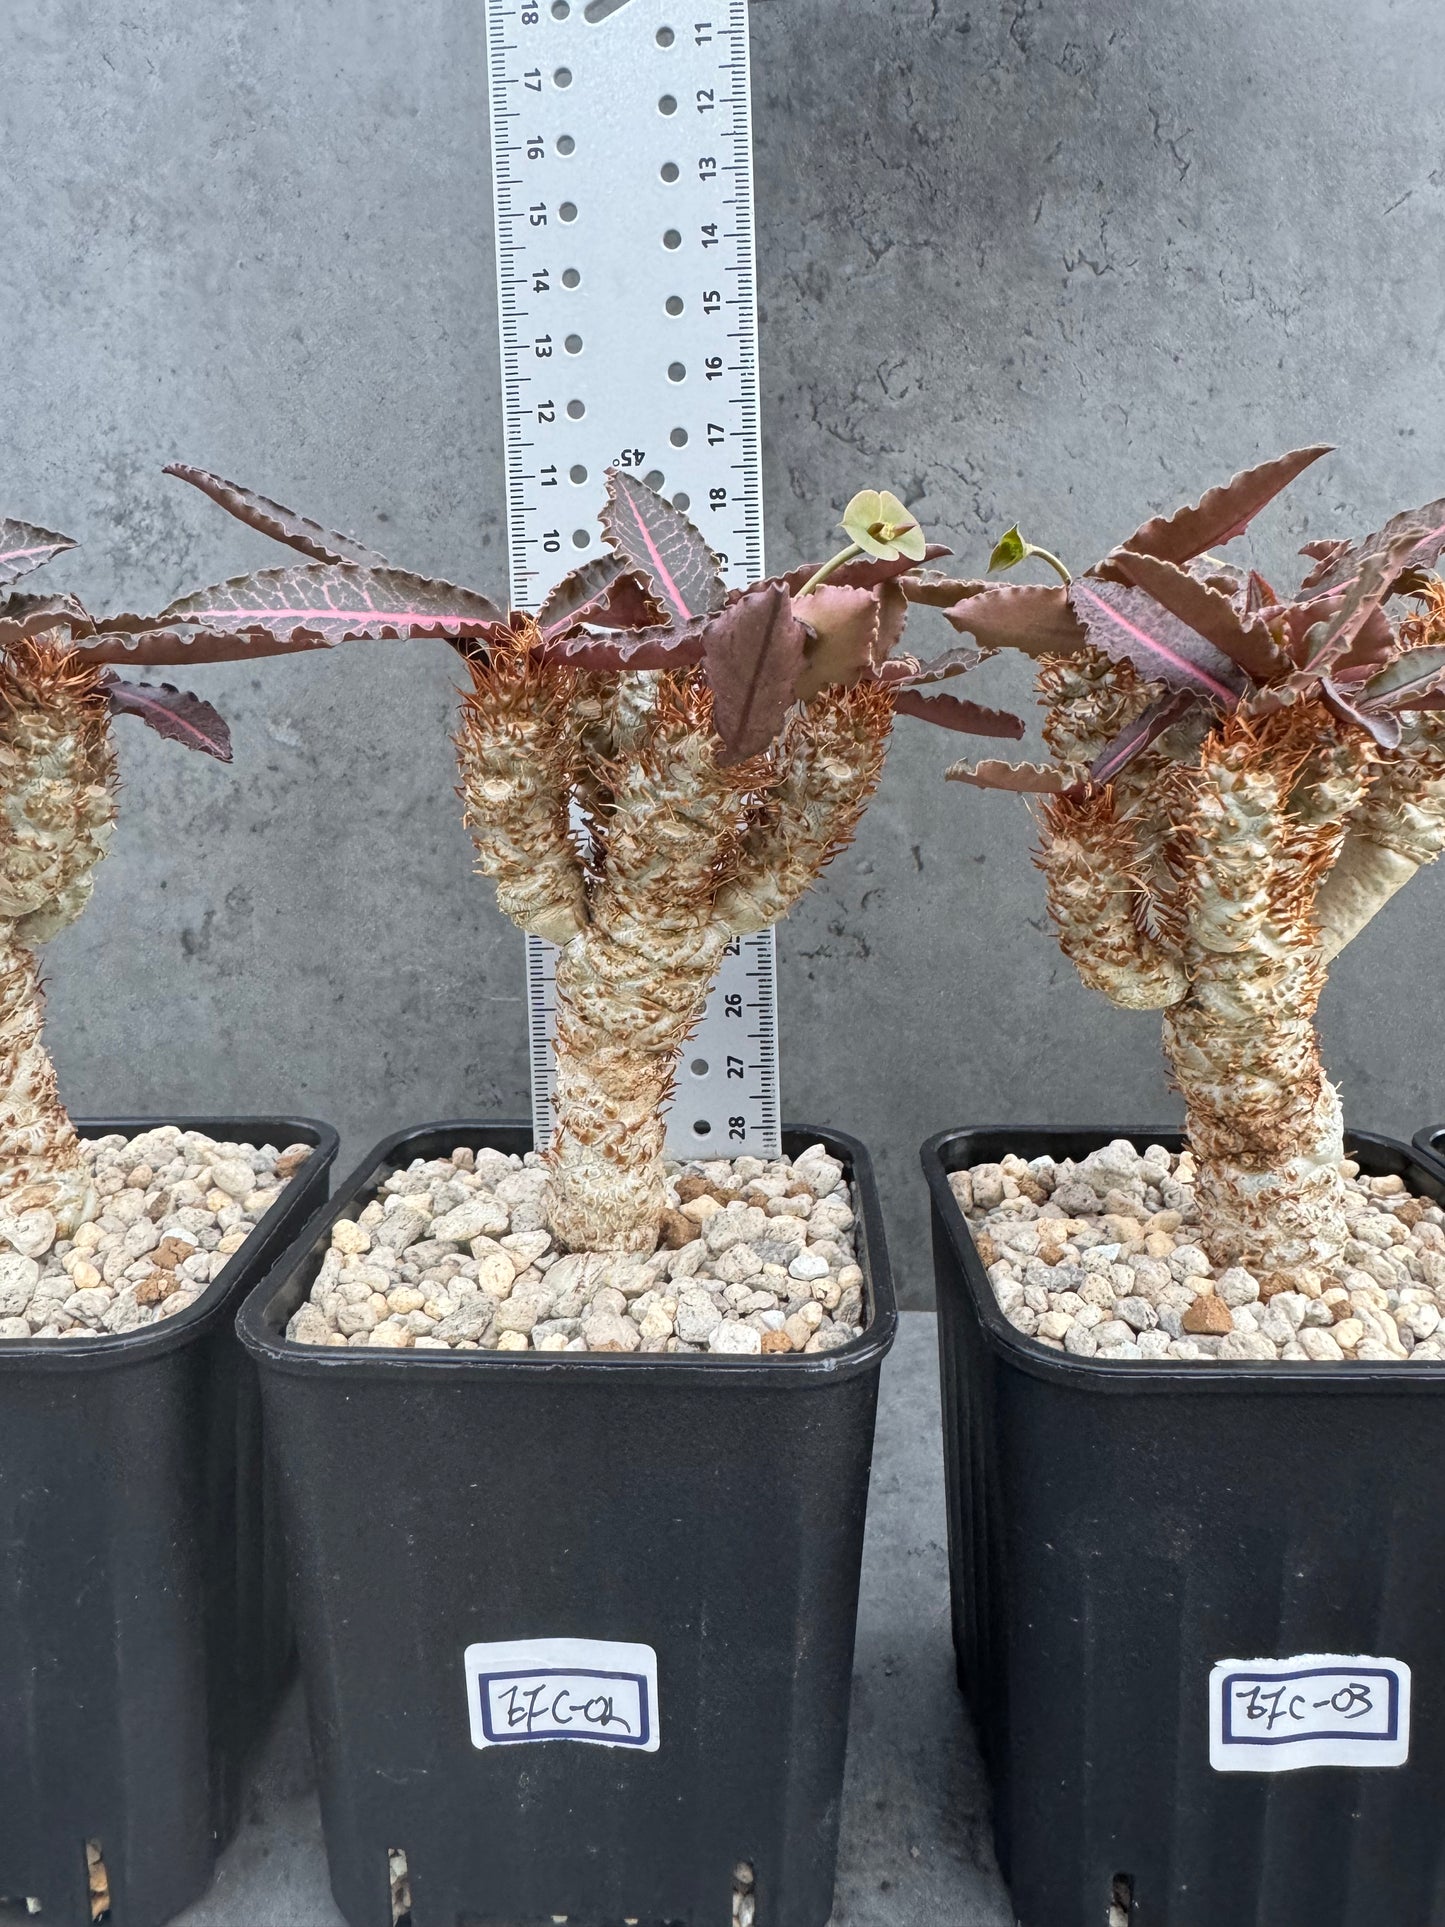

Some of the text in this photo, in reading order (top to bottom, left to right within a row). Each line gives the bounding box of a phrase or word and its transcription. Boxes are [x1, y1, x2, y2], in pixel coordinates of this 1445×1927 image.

[521, 0, 539, 25] 18
[694, 22, 712, 46] 11
[524, 67, 542, 92] 17
[696, 89, 715, 114] 12
[526, 135, 544, 160] 16
[699, 157, 717, 181] 13
[529, 202, 547, 226] 15
[701, 223, 719, 248] 14
[532, 269, 550, 293] 14
[703, 290, 721, 315] 15
[535, 334, 552, 358] 13
[705, 356, 723, 381] 16
[537, 400, 556, 424] 12
[708, 423, 725, 447] 17
[540, 464, 558, 487] 11
[709, 487, 727, 512] 18
[543, 529, 561, 553] 10
[725, 993, 742, 1018] 26
[727, 1055, 744, 1079] 27
[728, 1116, 746, 1141] 28
